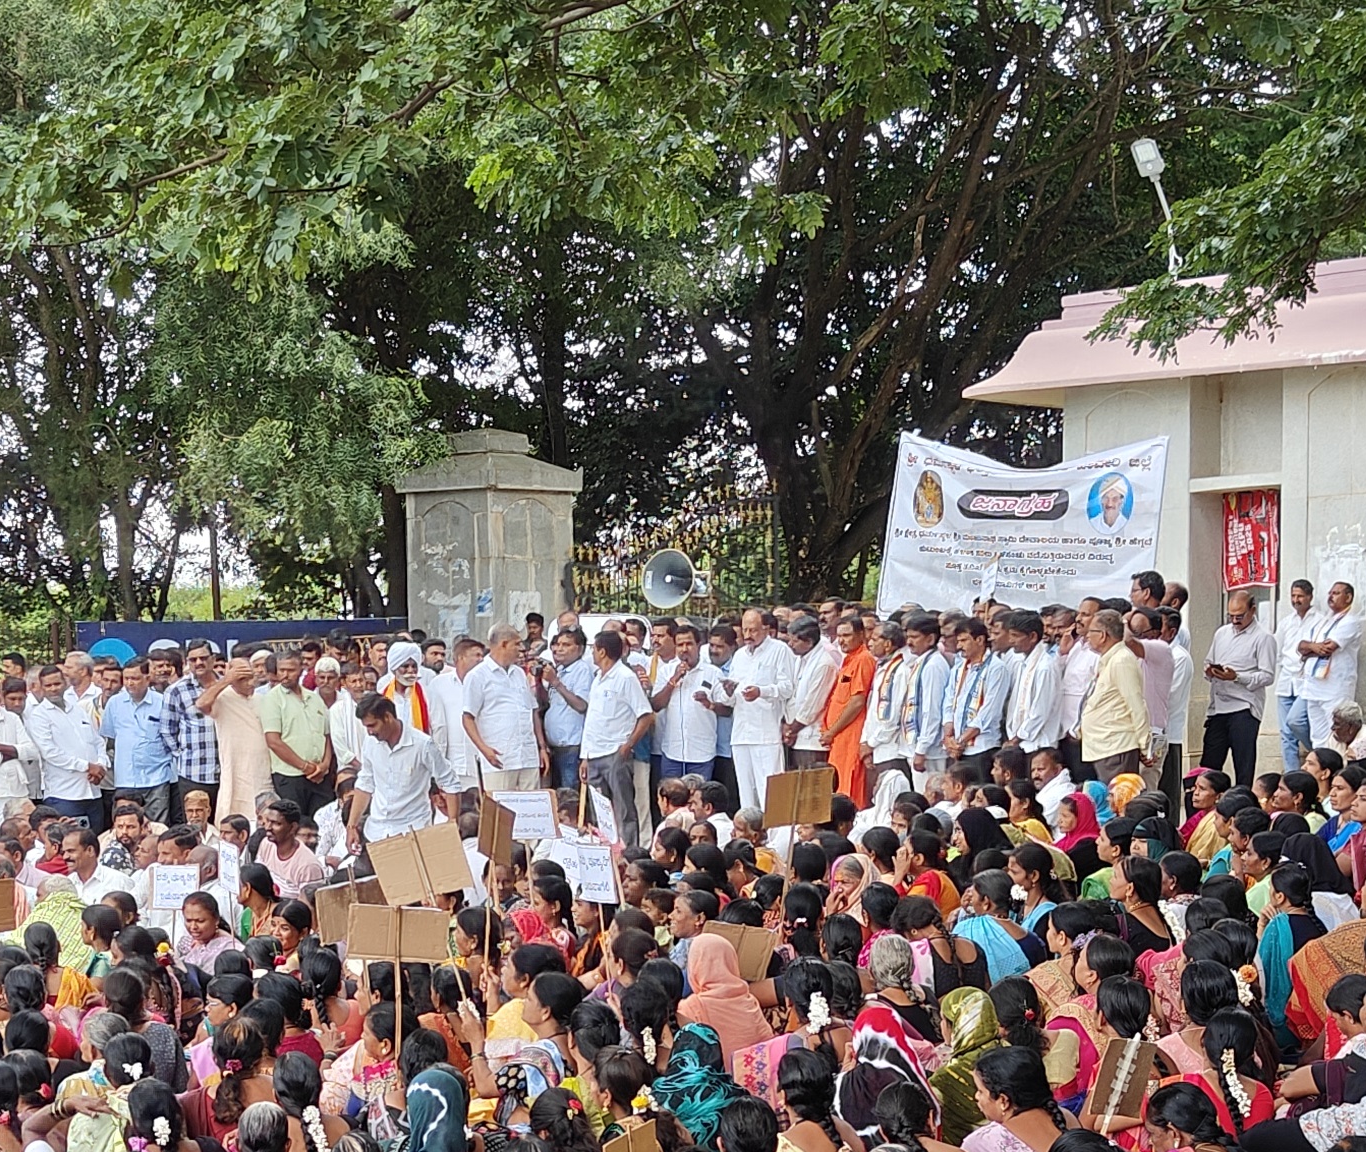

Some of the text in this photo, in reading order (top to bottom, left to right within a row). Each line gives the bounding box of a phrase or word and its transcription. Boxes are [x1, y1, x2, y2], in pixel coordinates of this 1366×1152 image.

[971, 493, 1055, 516] ಜನಾಗ್ರಹ
[1019, 535, 1059, 543] ದೇವಾಲಯ
[1114, 537, 1126, 547] ಶ್ರೀ
[1244, 523, 1254, 551] 2025
